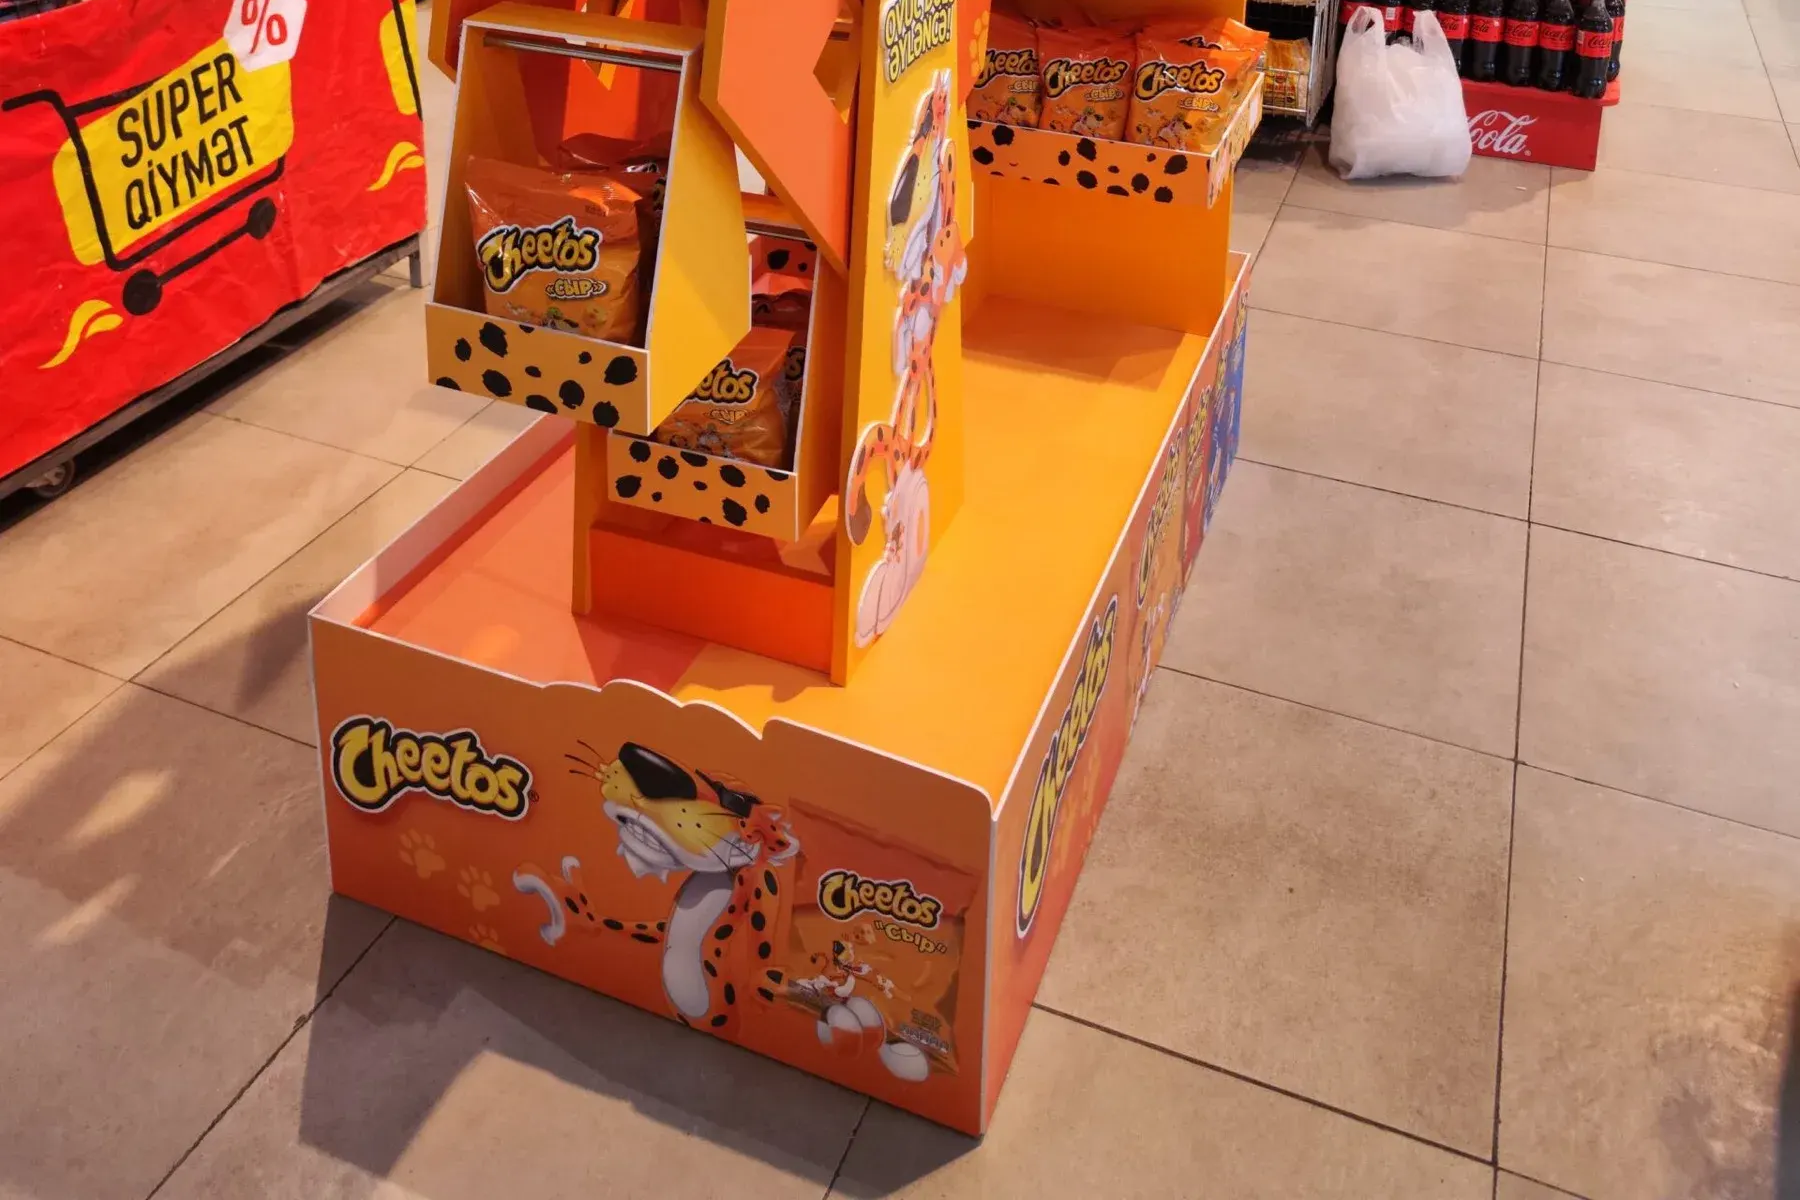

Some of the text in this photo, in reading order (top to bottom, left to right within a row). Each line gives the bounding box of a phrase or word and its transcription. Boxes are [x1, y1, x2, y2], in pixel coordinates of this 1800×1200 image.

[117, 52, 243, 168] SUPER
[1043, 58, 1130, 100] Cheetos
[1133, 61, 1225, 102] Cheetos
[478, 217, 601, 293] Cheetos
[332, 716, 532, 820] Cheetos
[1018, 595, 1117, 938] Cheetos
[818, 870, 942, 929] Cheetos
